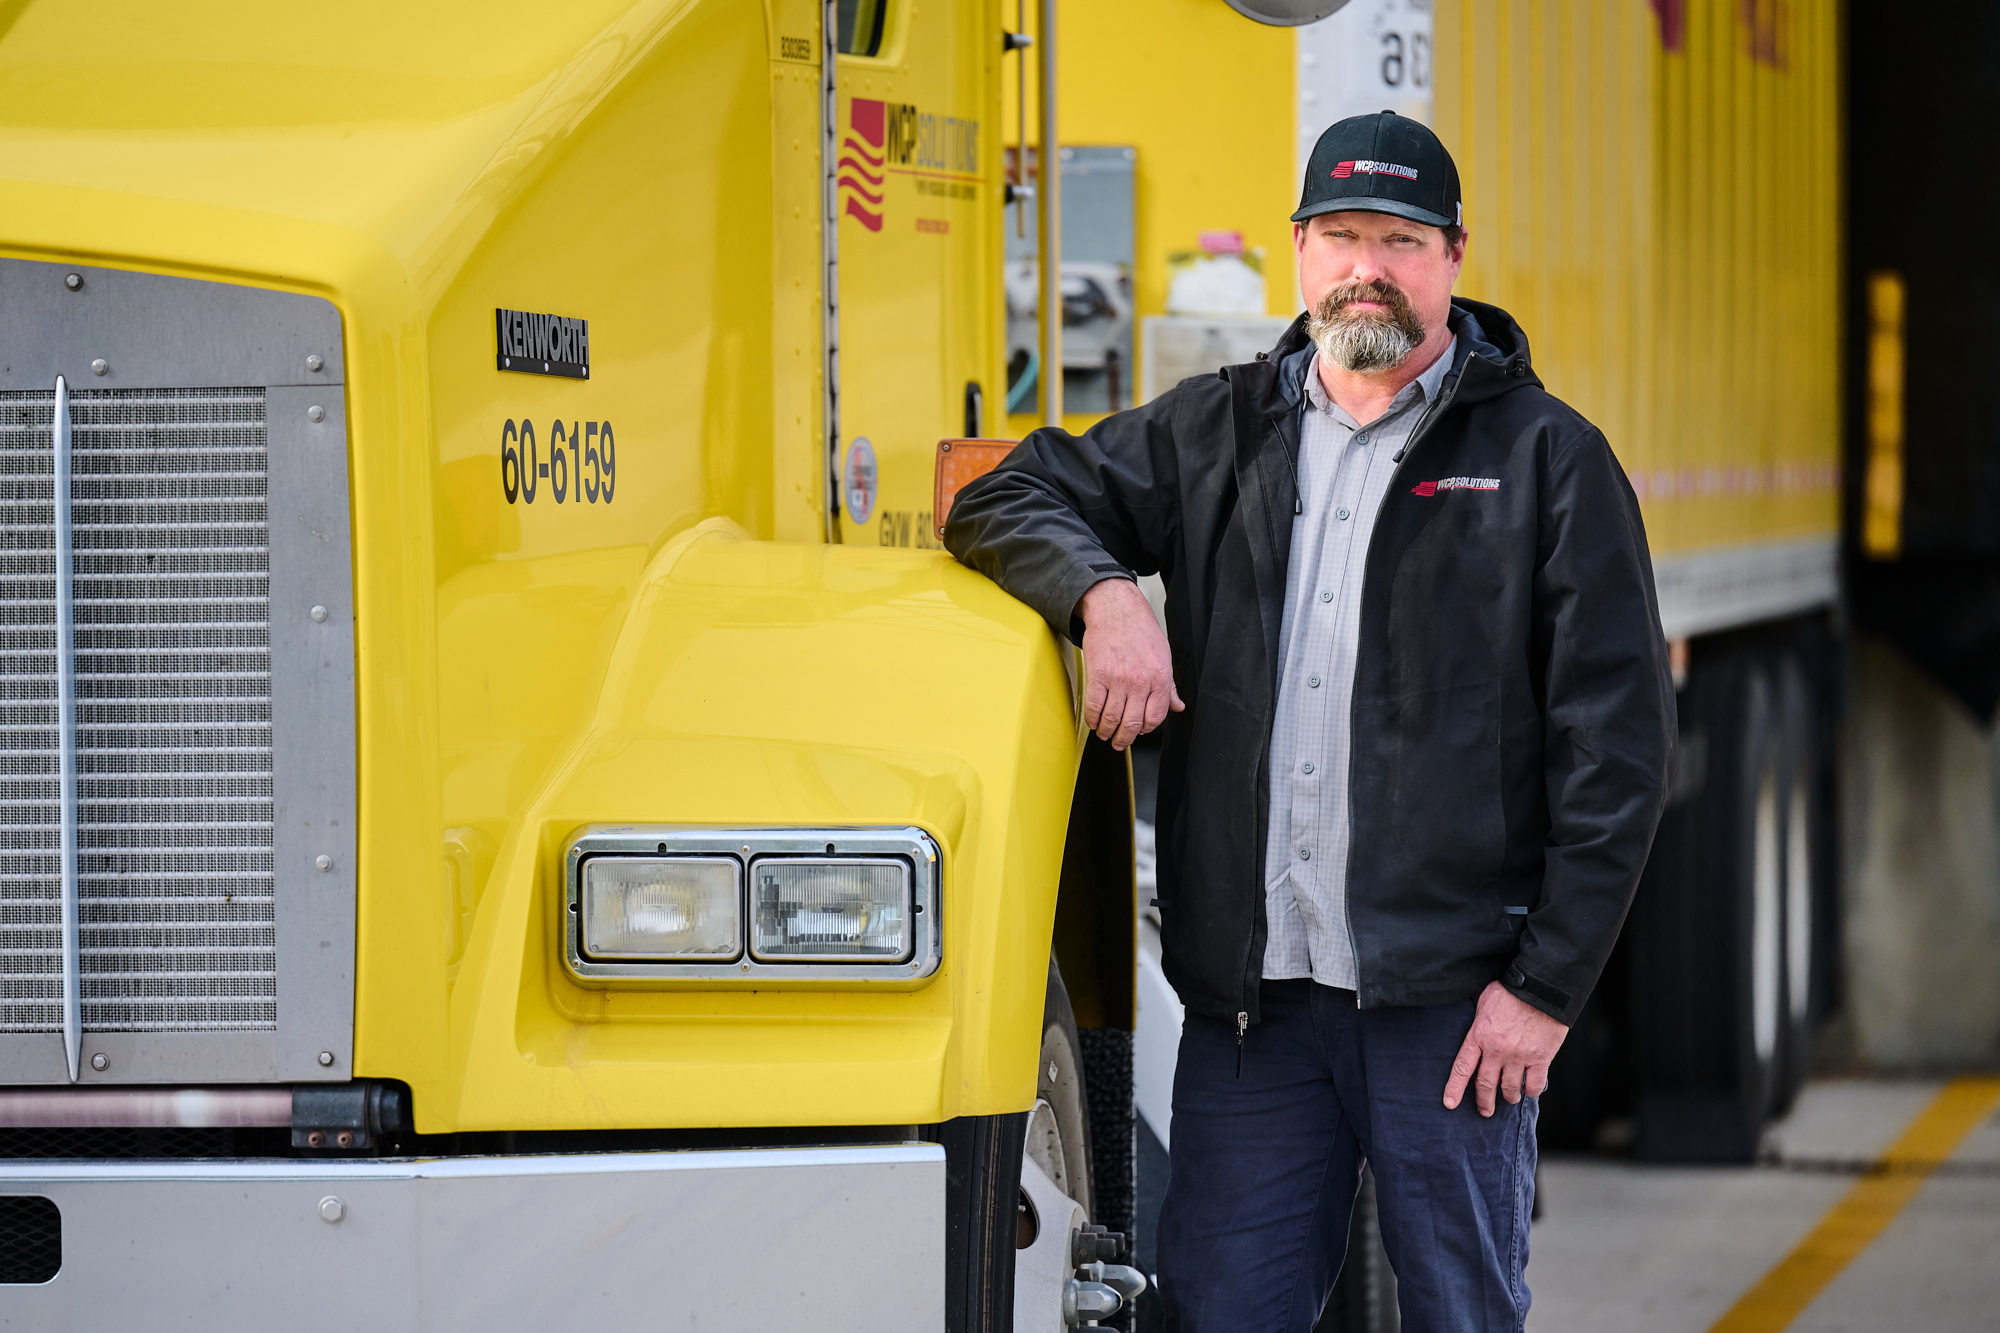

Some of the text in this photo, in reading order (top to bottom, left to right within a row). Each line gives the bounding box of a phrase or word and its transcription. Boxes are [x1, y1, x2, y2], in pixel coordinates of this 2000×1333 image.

[887, 103, 979, 173] WCP SOLUTIONS
[1373, 162, 1419, 179] SOLUTIONS
[501, 308, 589, 365] KENWORTH
[502, 418, 616, 505] 60-6159
[1454, 476, 1501, 489] SOLUTIONS
